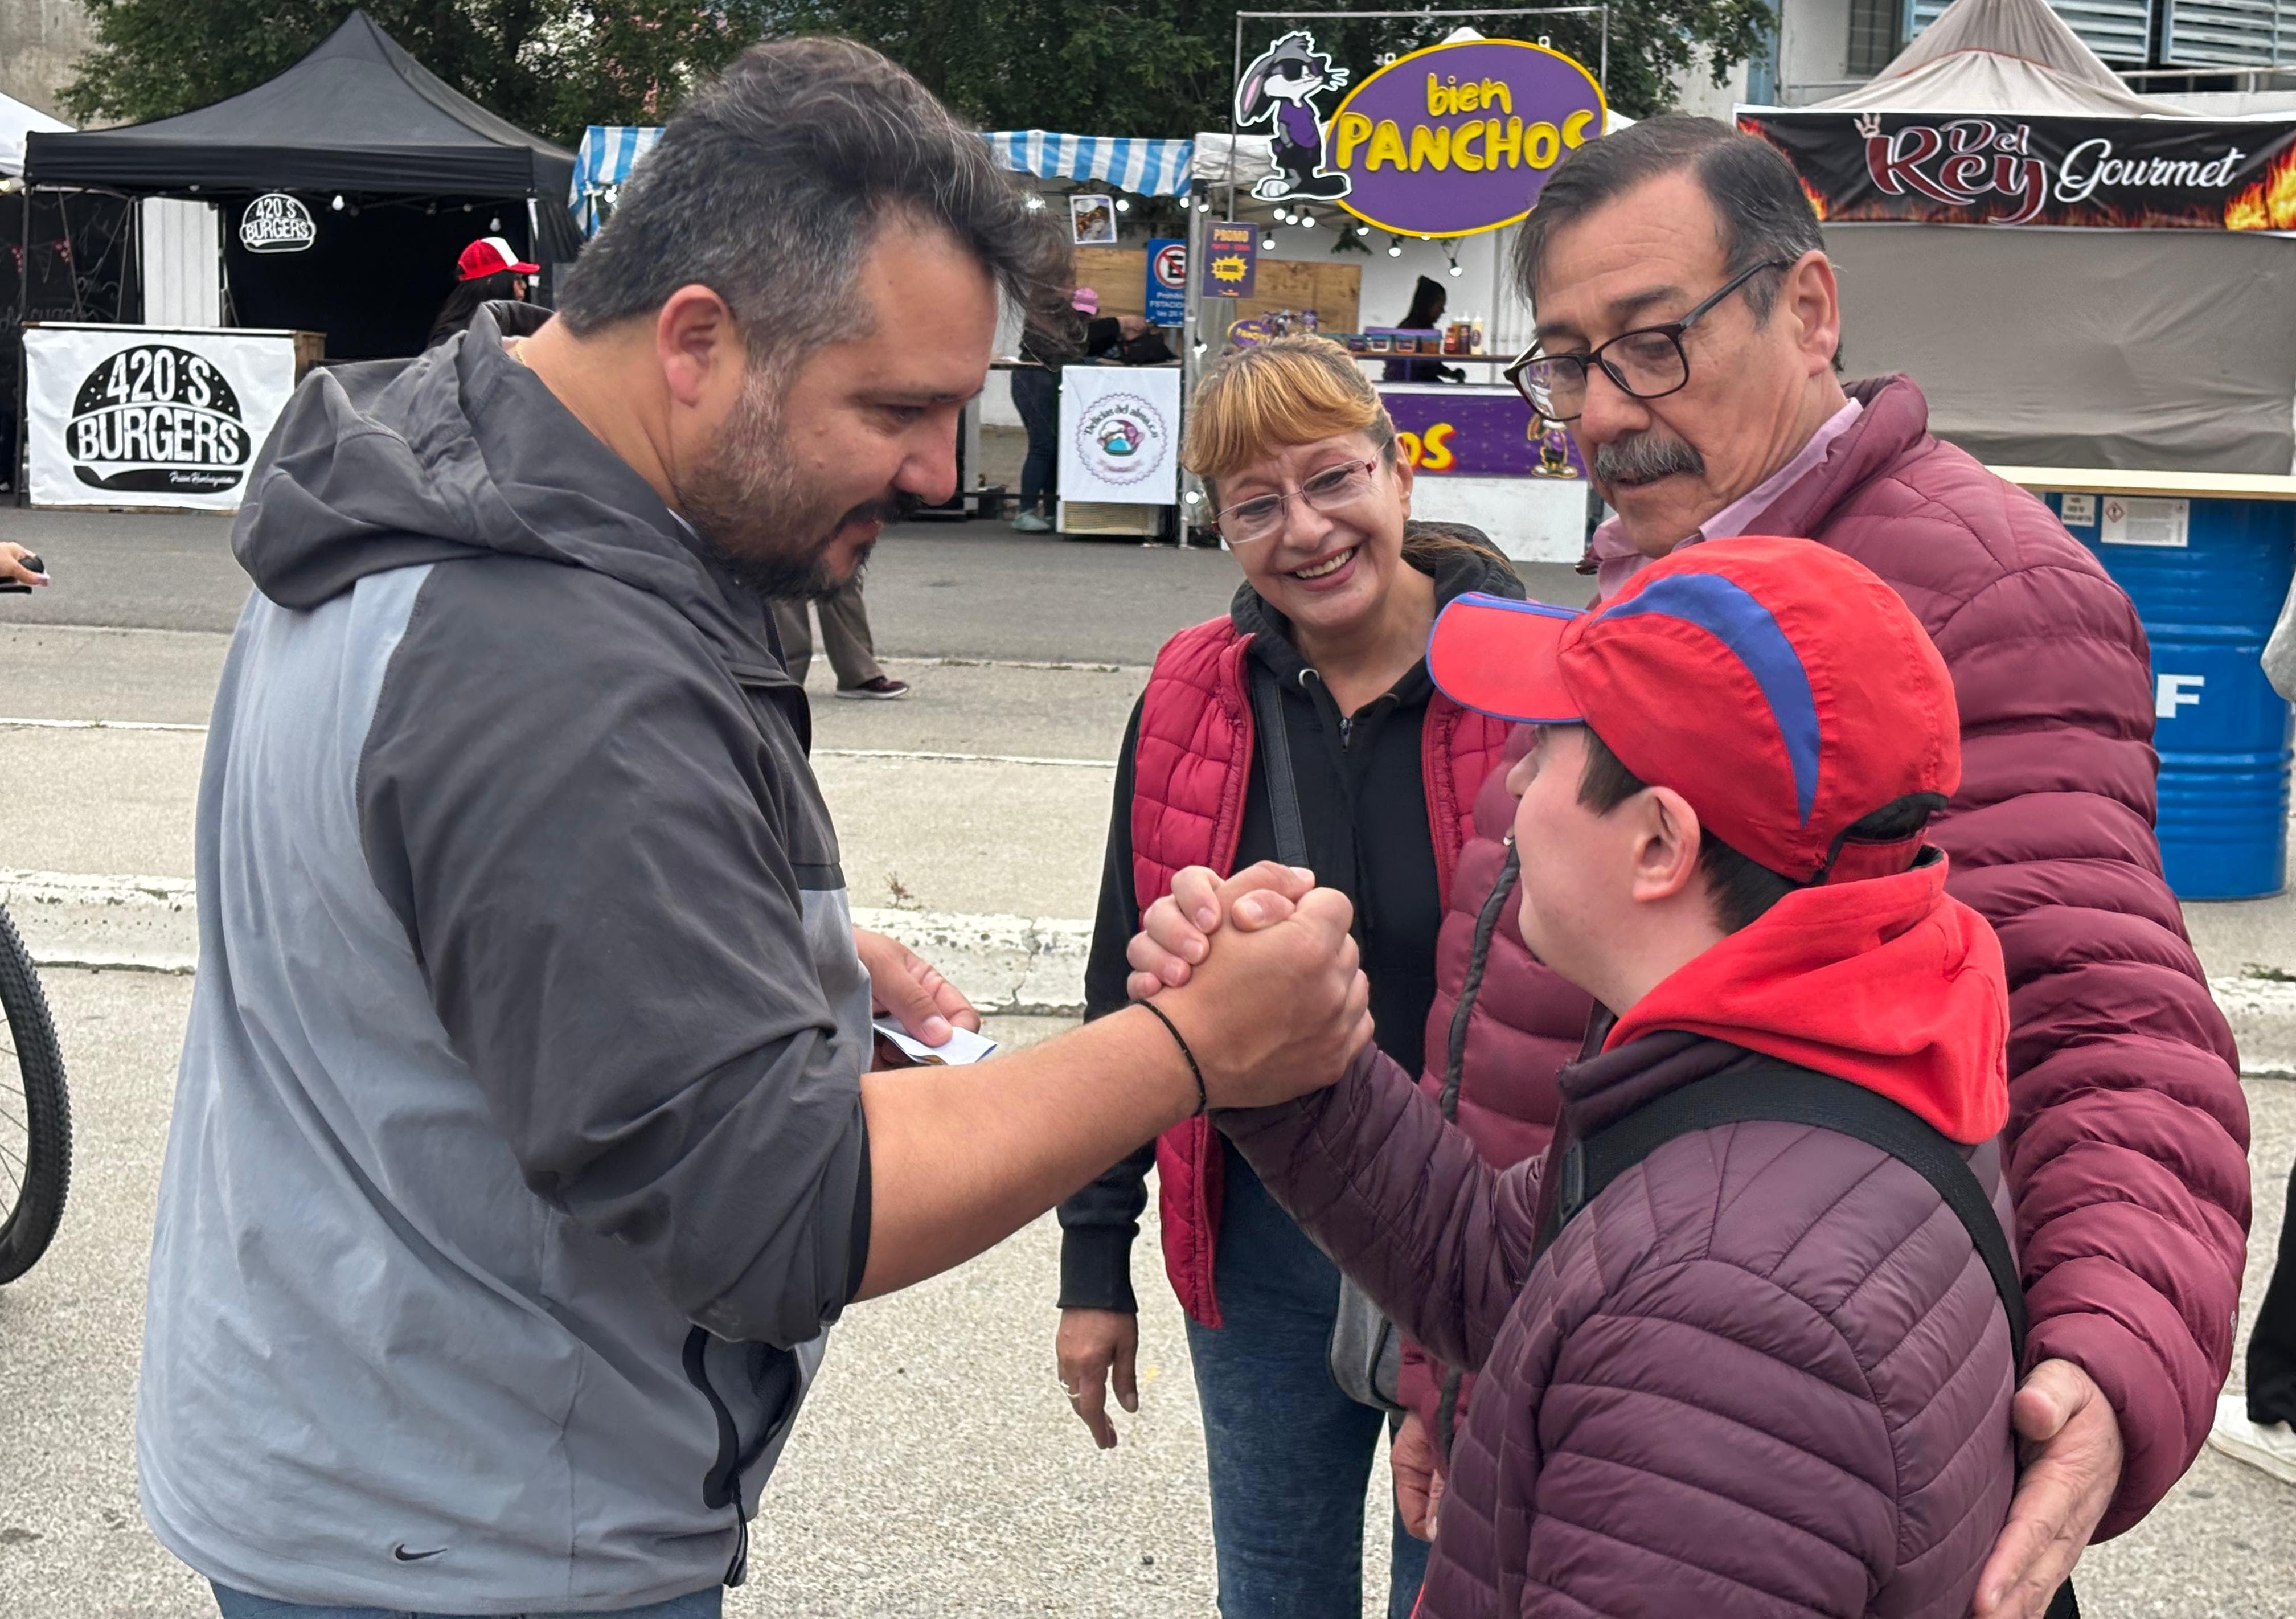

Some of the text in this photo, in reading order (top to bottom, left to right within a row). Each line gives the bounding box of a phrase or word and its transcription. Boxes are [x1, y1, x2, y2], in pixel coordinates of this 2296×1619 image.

[1428, 73, 1512, 117] bien
[1938, 118, 2030, 155] Del
[1865, 125, 2246, 226] Rey Gourmet
[245, 218, 309, 241] BURGERS
[77, 407, 240, 465] BURGERS
